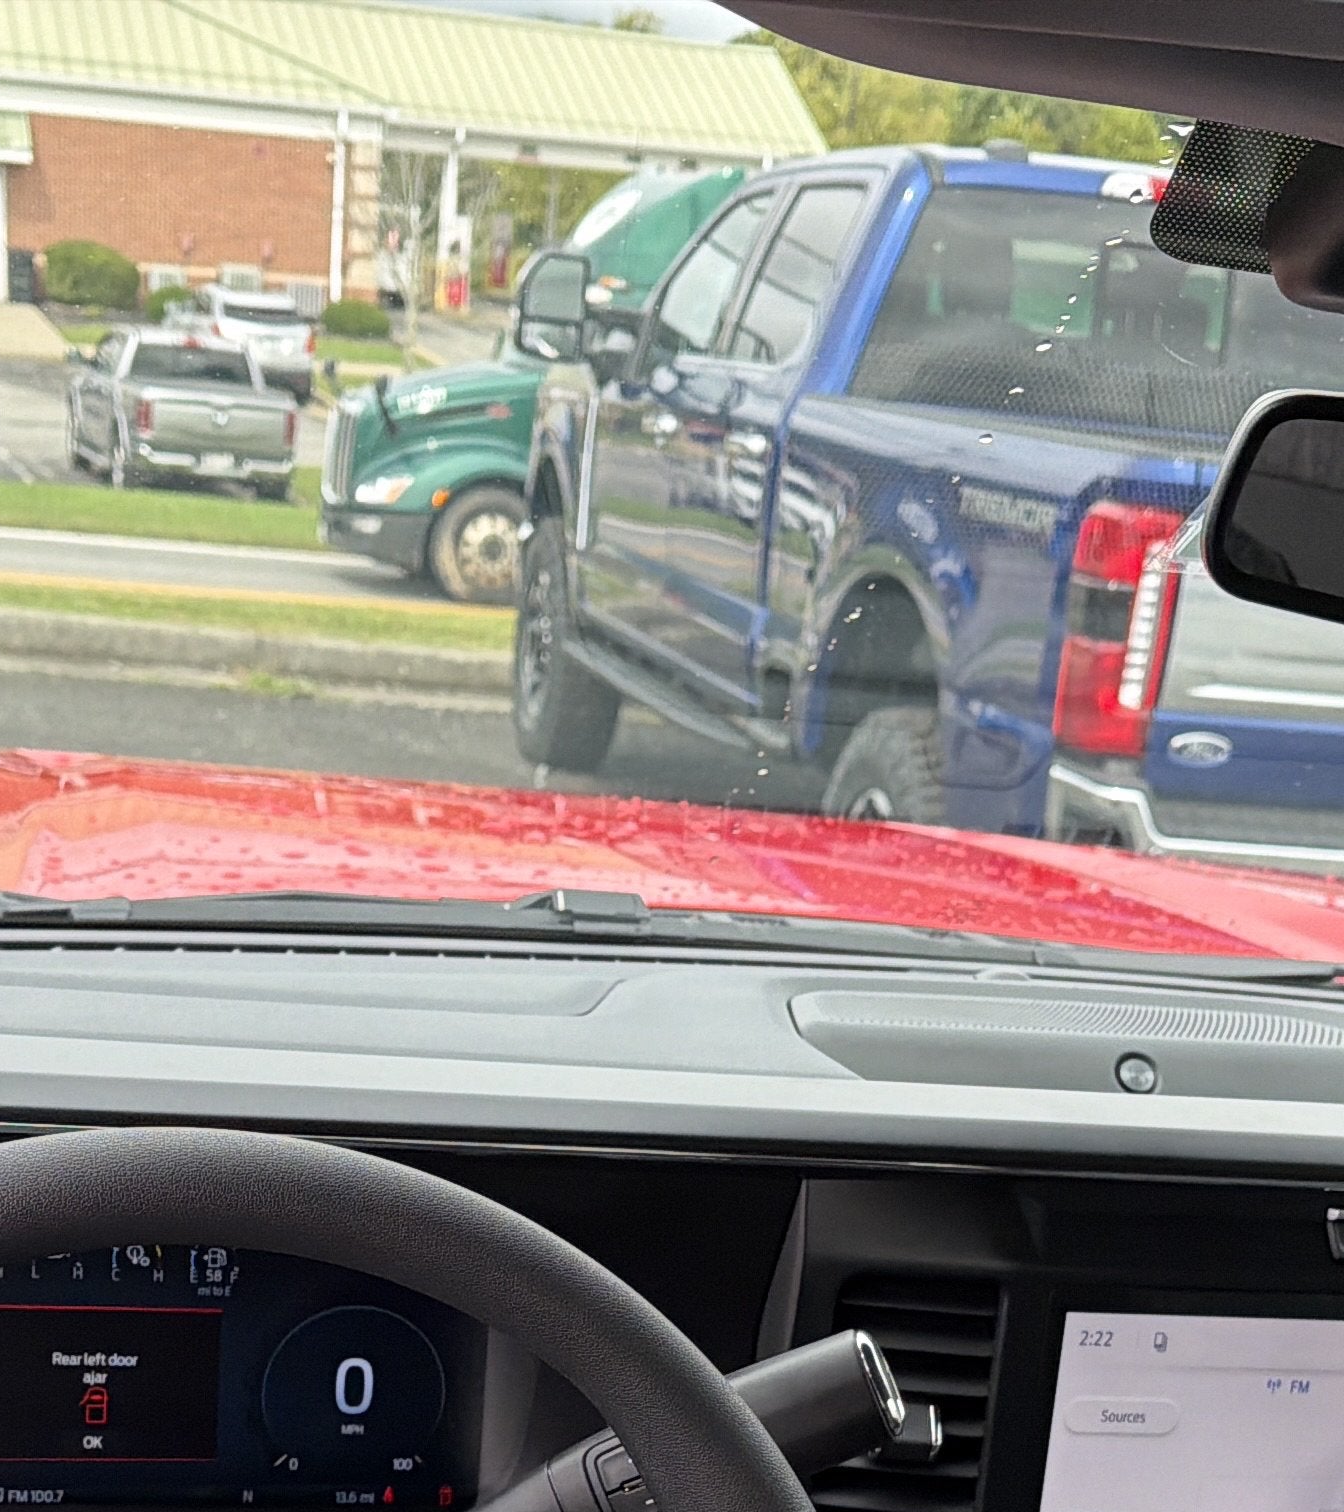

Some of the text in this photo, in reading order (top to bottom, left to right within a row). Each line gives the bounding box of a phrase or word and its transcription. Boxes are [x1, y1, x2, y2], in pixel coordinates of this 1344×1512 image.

[111, 1268, 120, 1282] C
[153, 1269, 164, 1283] H
[206, 1268, 223, 1283] 58
[1078, 1330, 1114, 1348] 2:22
[52, 1351, 139, 1368] Rear left door
[83, 1370, 108, 1386] ajar
[335, 1357, 374, 1415] 0
[1289, 1379, 1311, 1394] FM
[1101, 1409, 1147, 1424] Sources
[340, 1423, 365, 1436] MPH
[82, 1435, 104, 1450] OK
[288, 1457, 299, 1471] 0
[392, 1457, 414, 1472] 100
[7, 1489, 65, 1503] FM 100.7
[242, 1489, 254, 1504] N
